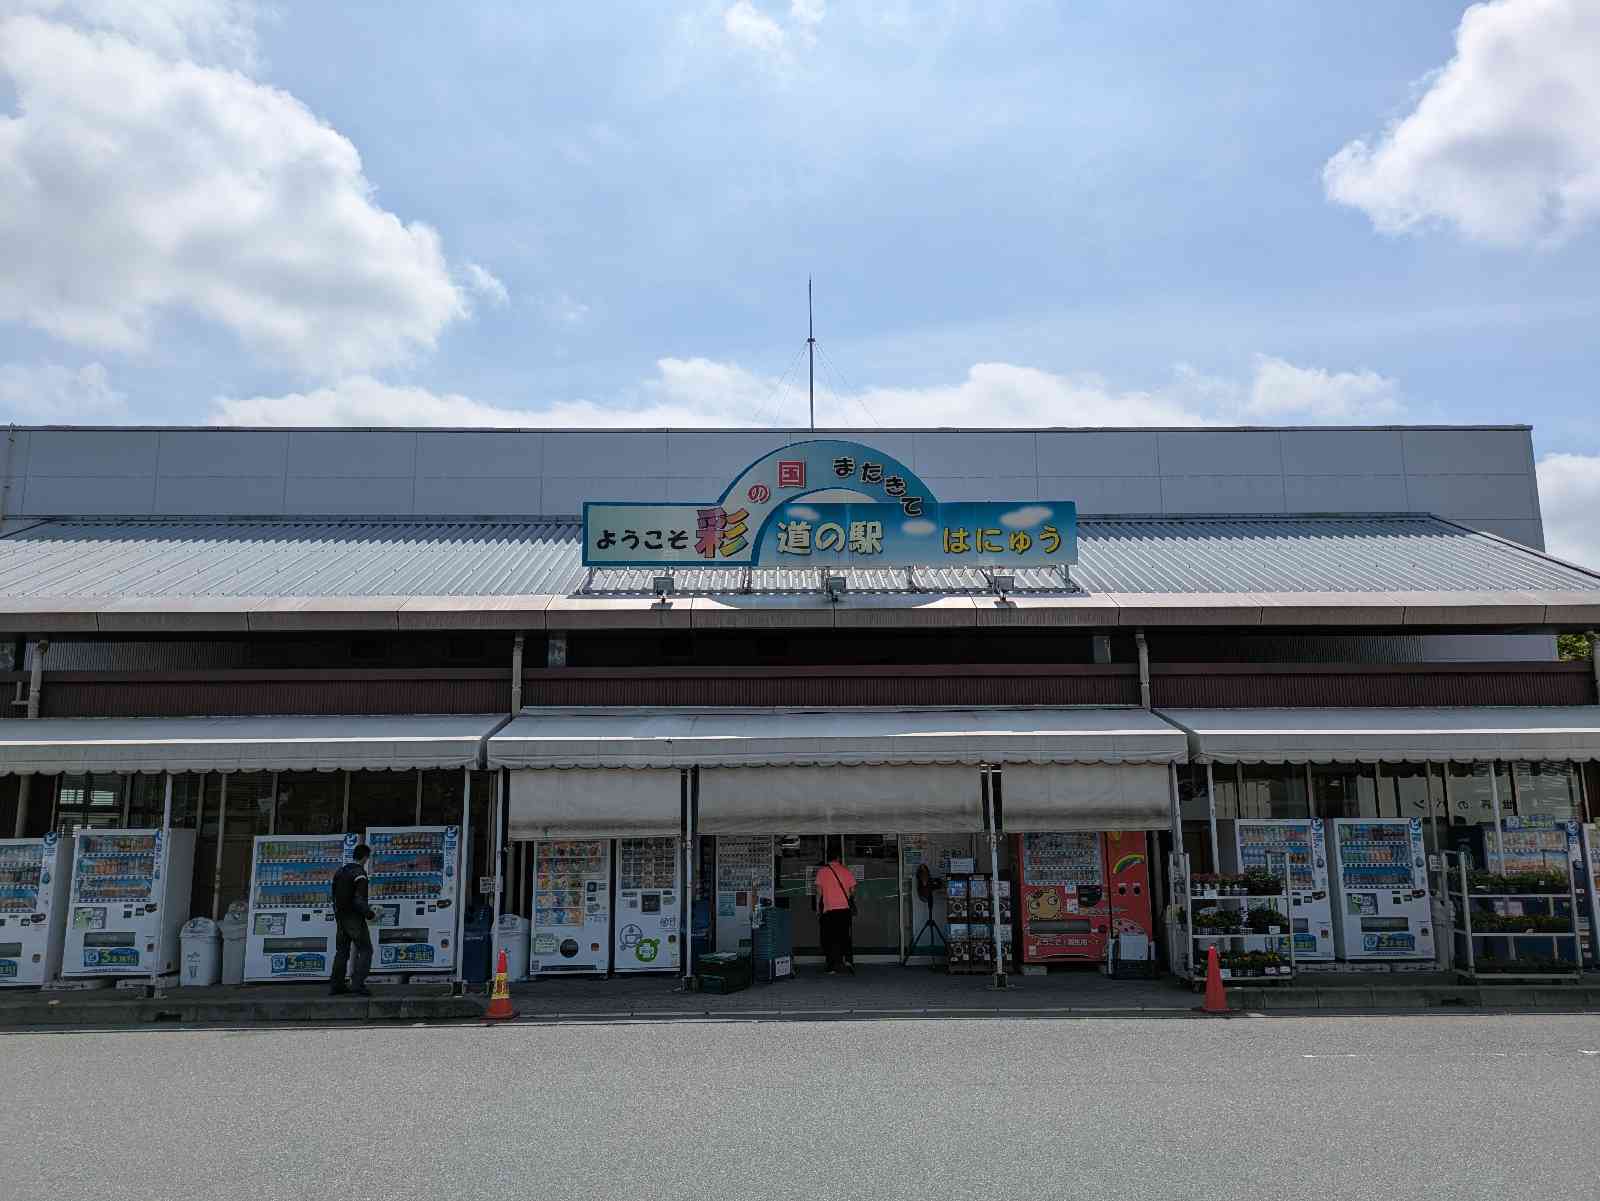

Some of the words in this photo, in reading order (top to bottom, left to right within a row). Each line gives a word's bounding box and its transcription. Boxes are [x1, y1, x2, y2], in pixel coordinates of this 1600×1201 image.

[596, 528, 690, 551] ようこそ
[776, 520, 884, 555] 道の駅
[941, 524, 1063, 554] はにゅう
